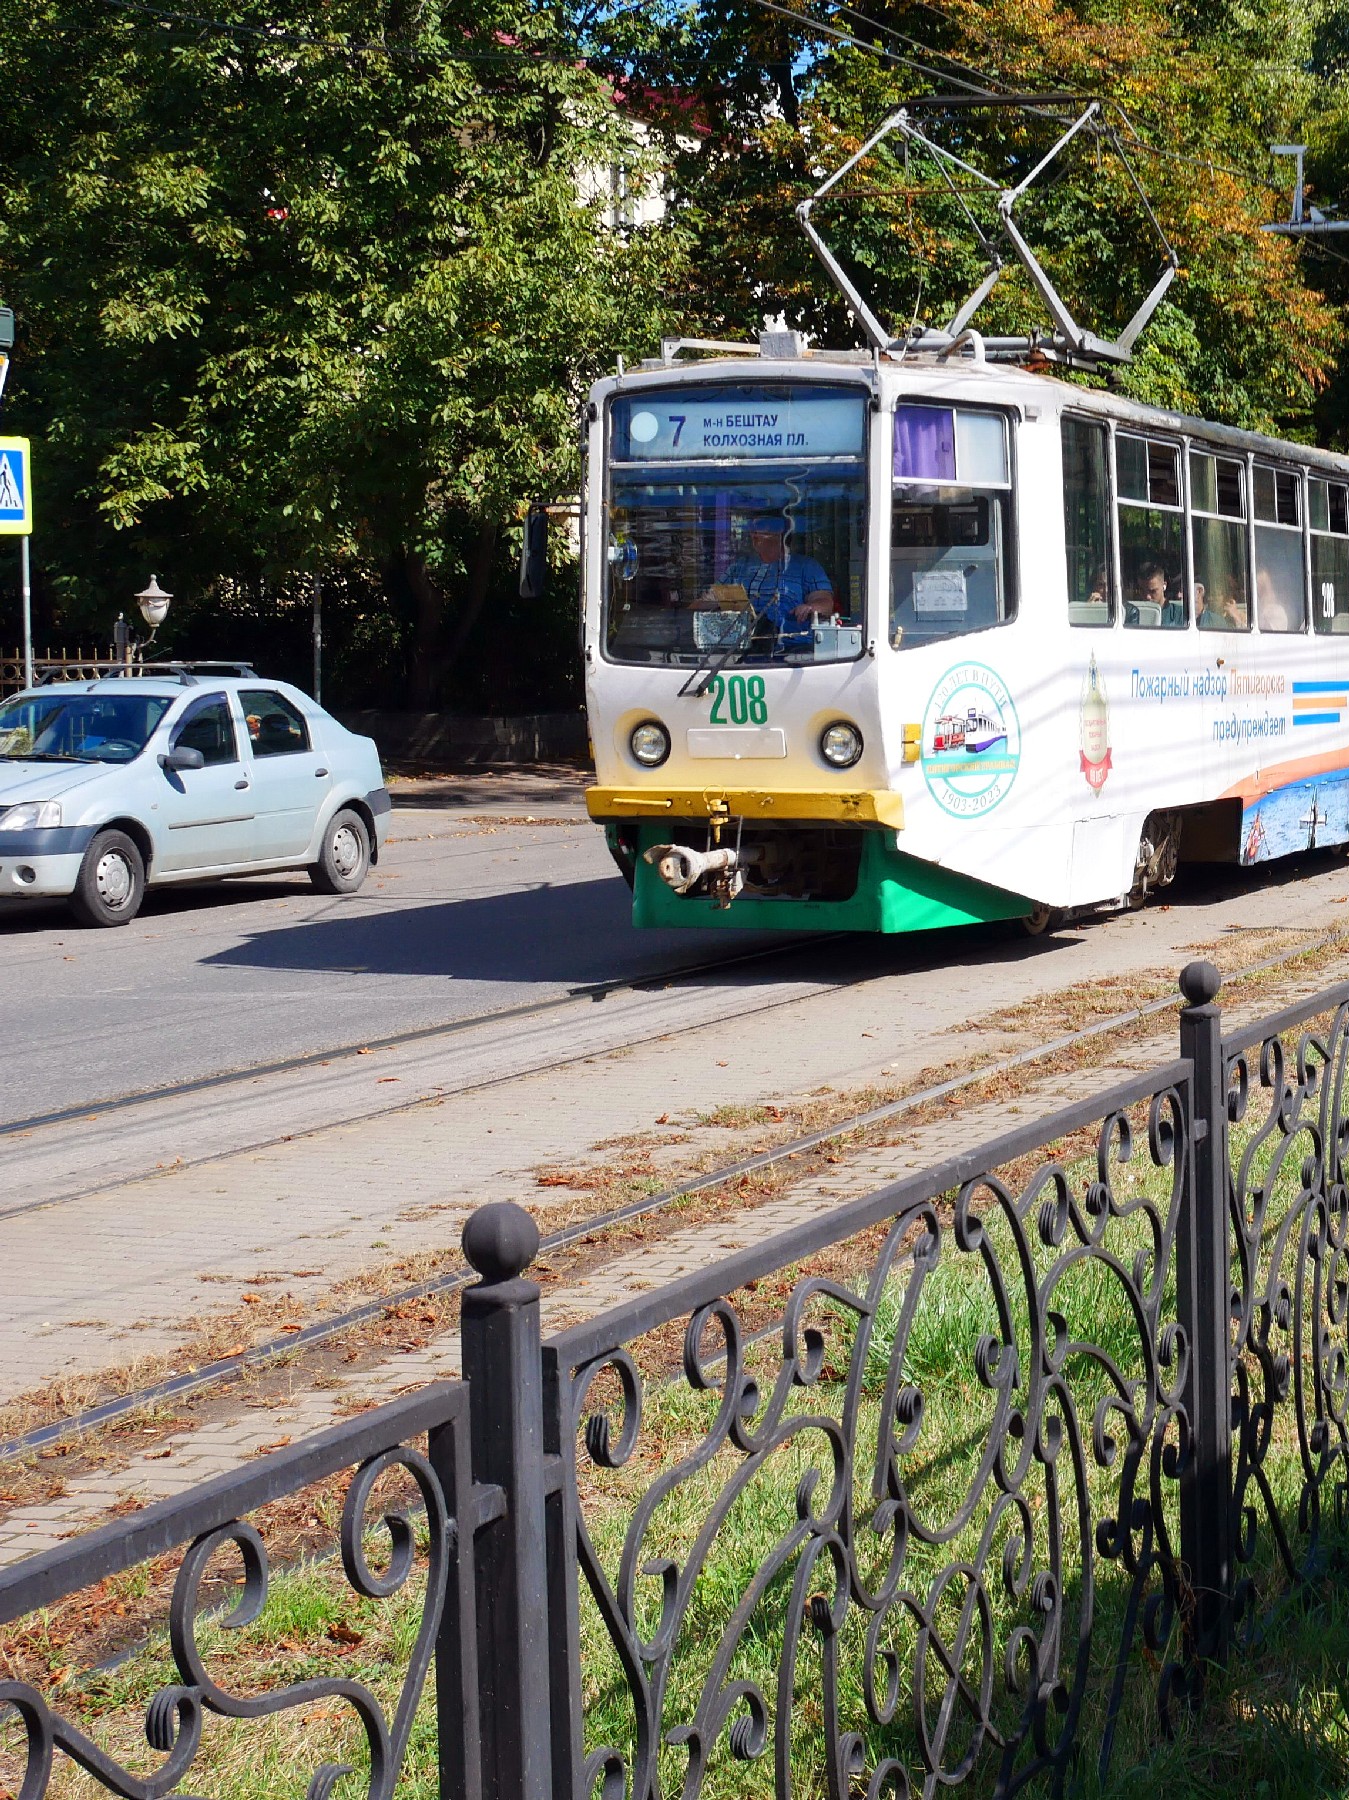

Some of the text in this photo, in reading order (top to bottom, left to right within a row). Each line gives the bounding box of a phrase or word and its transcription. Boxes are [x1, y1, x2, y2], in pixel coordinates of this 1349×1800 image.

[668, 415, 687, 448] 7
[726, 414, 778, 428] БЕШТАУ
[703, 433, 809, 447] КОЛХОЗНАЯ ПЛ.
[949, 669, 969, 690] ЛЕТ
[972, 669, 979, 682] В
[1131, 668, 1285, 704] Пожарный надзор Пятигорска
[707, 675, 768, 725] 208
[1213, 710, 1286, 748] предупреждает
